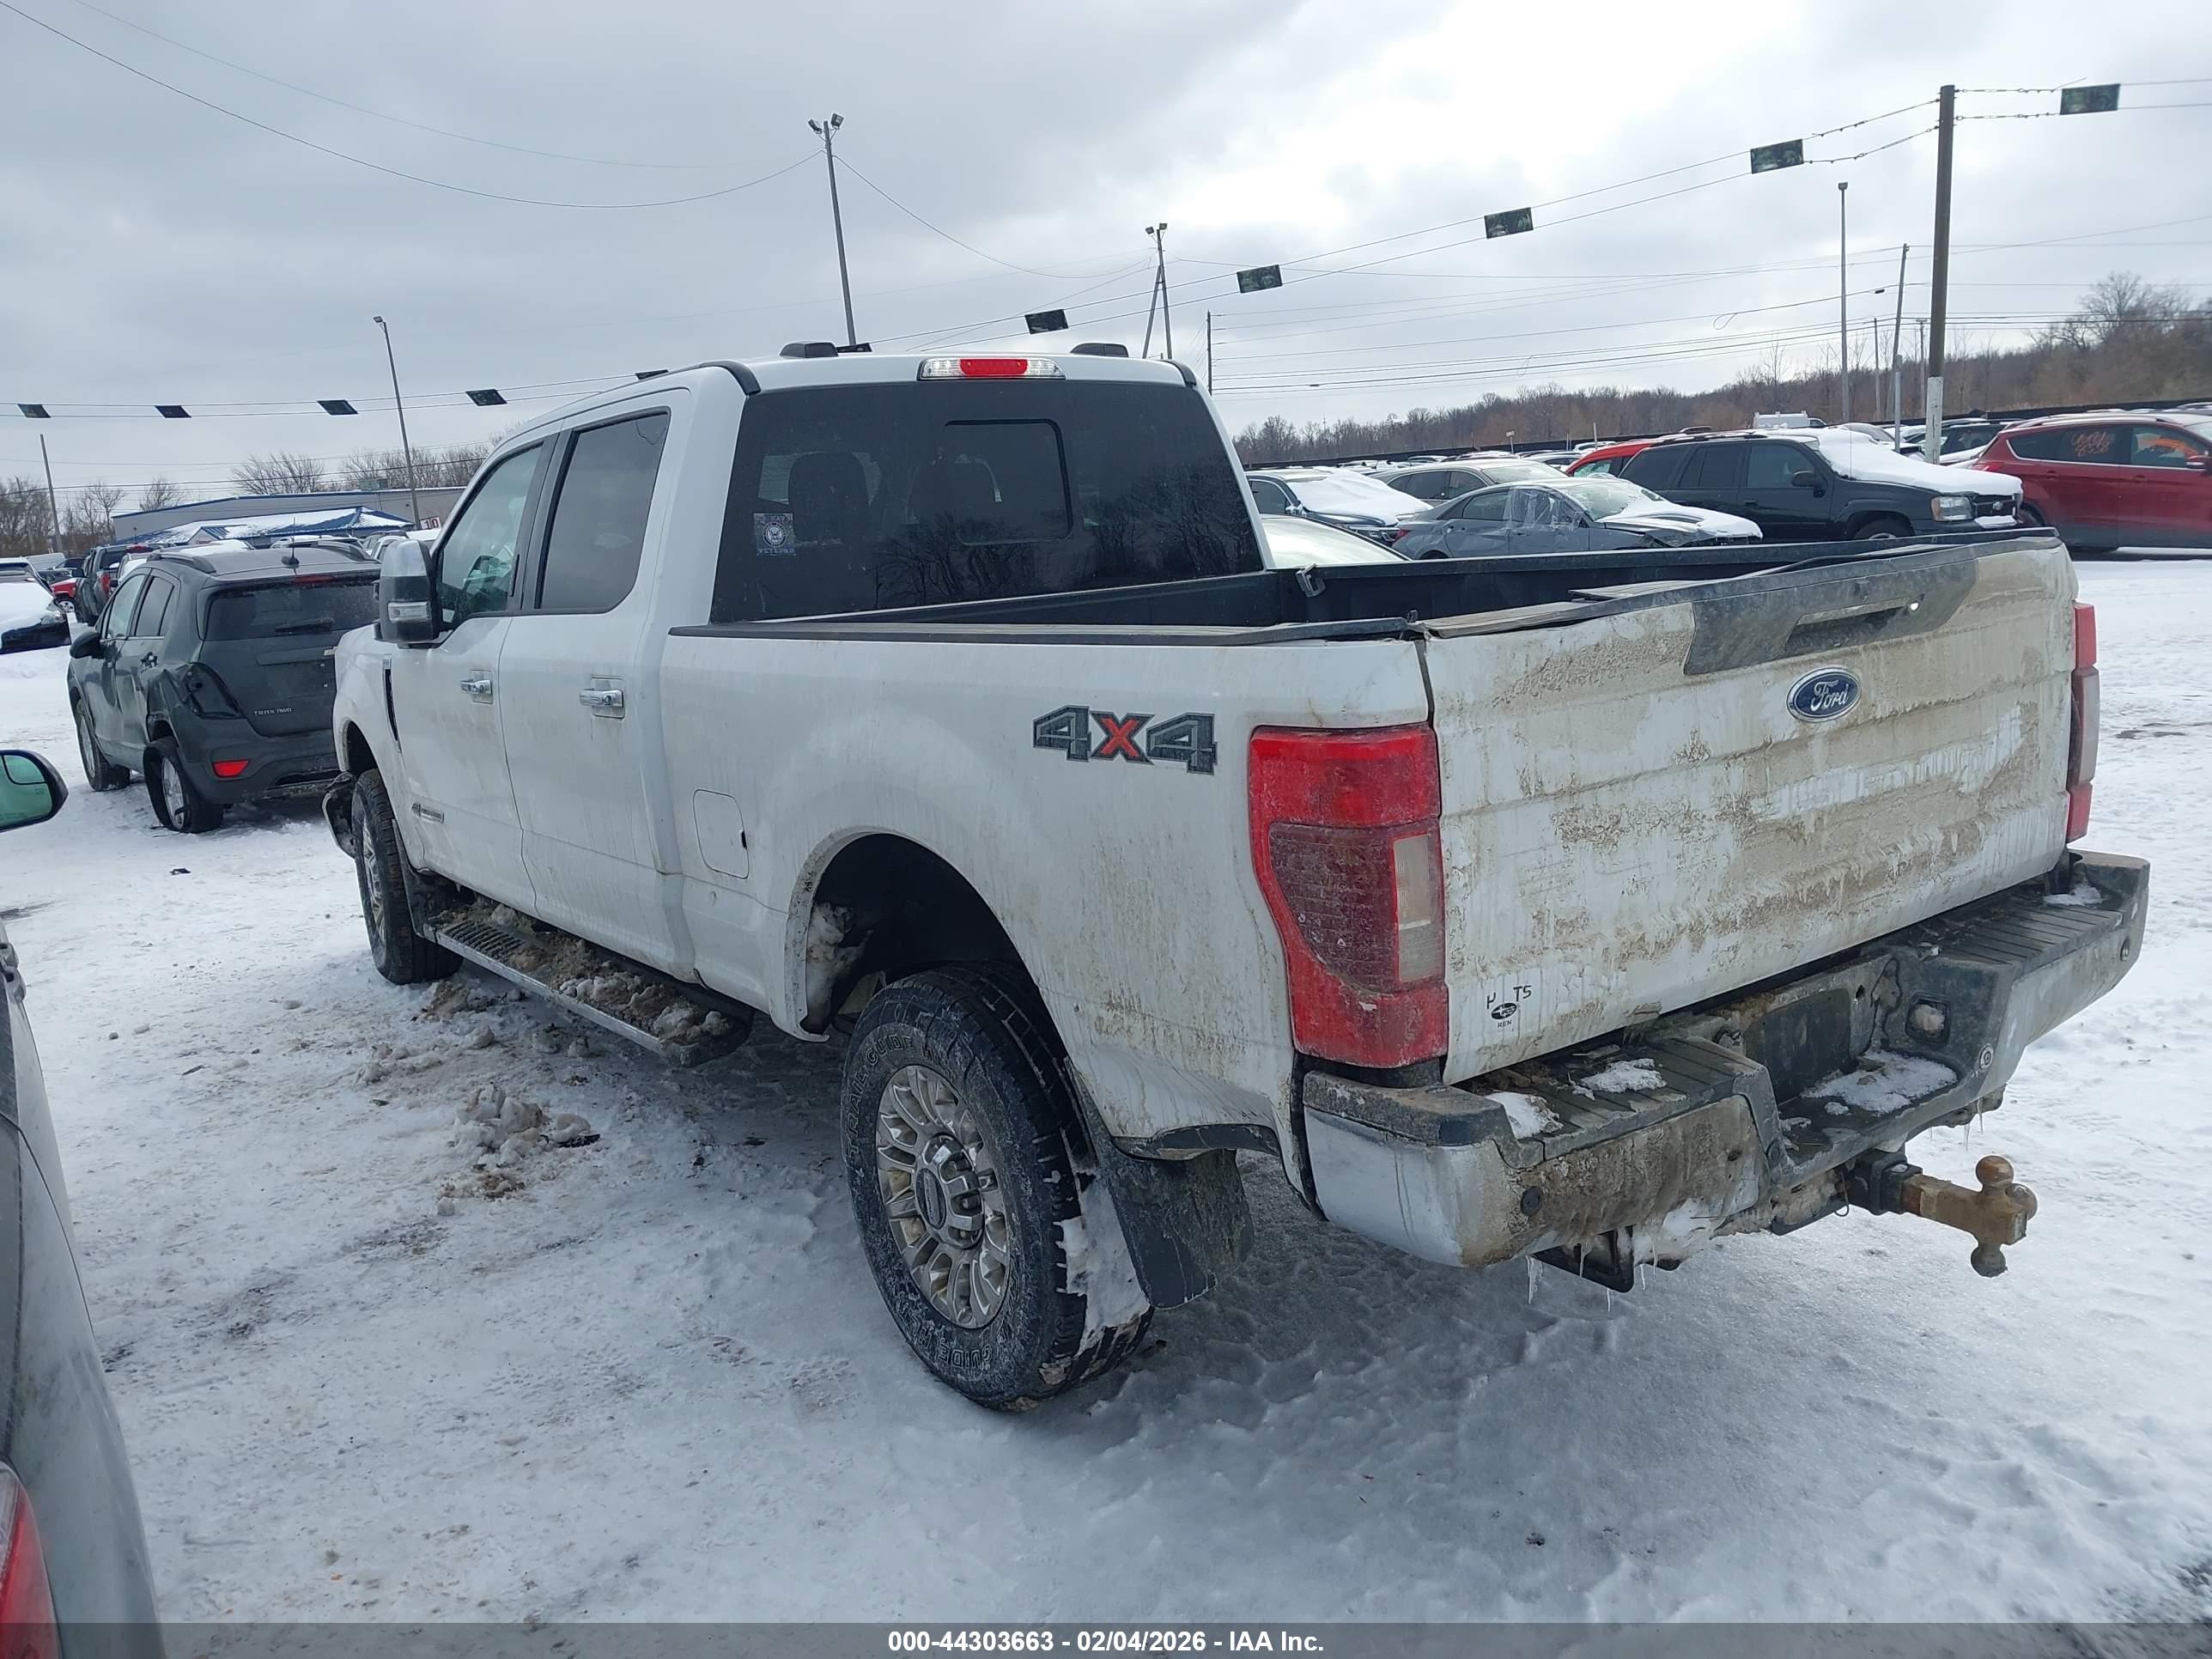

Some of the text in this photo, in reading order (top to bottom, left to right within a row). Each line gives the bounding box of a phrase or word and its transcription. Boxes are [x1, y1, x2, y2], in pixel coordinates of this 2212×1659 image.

[424, 518, 440, 528] 10
[1810, 680, 1849, 712] Ford
[1033, 705, 1218, 776] 4X4
[865, 1033, 915, 1066] GUIDE
